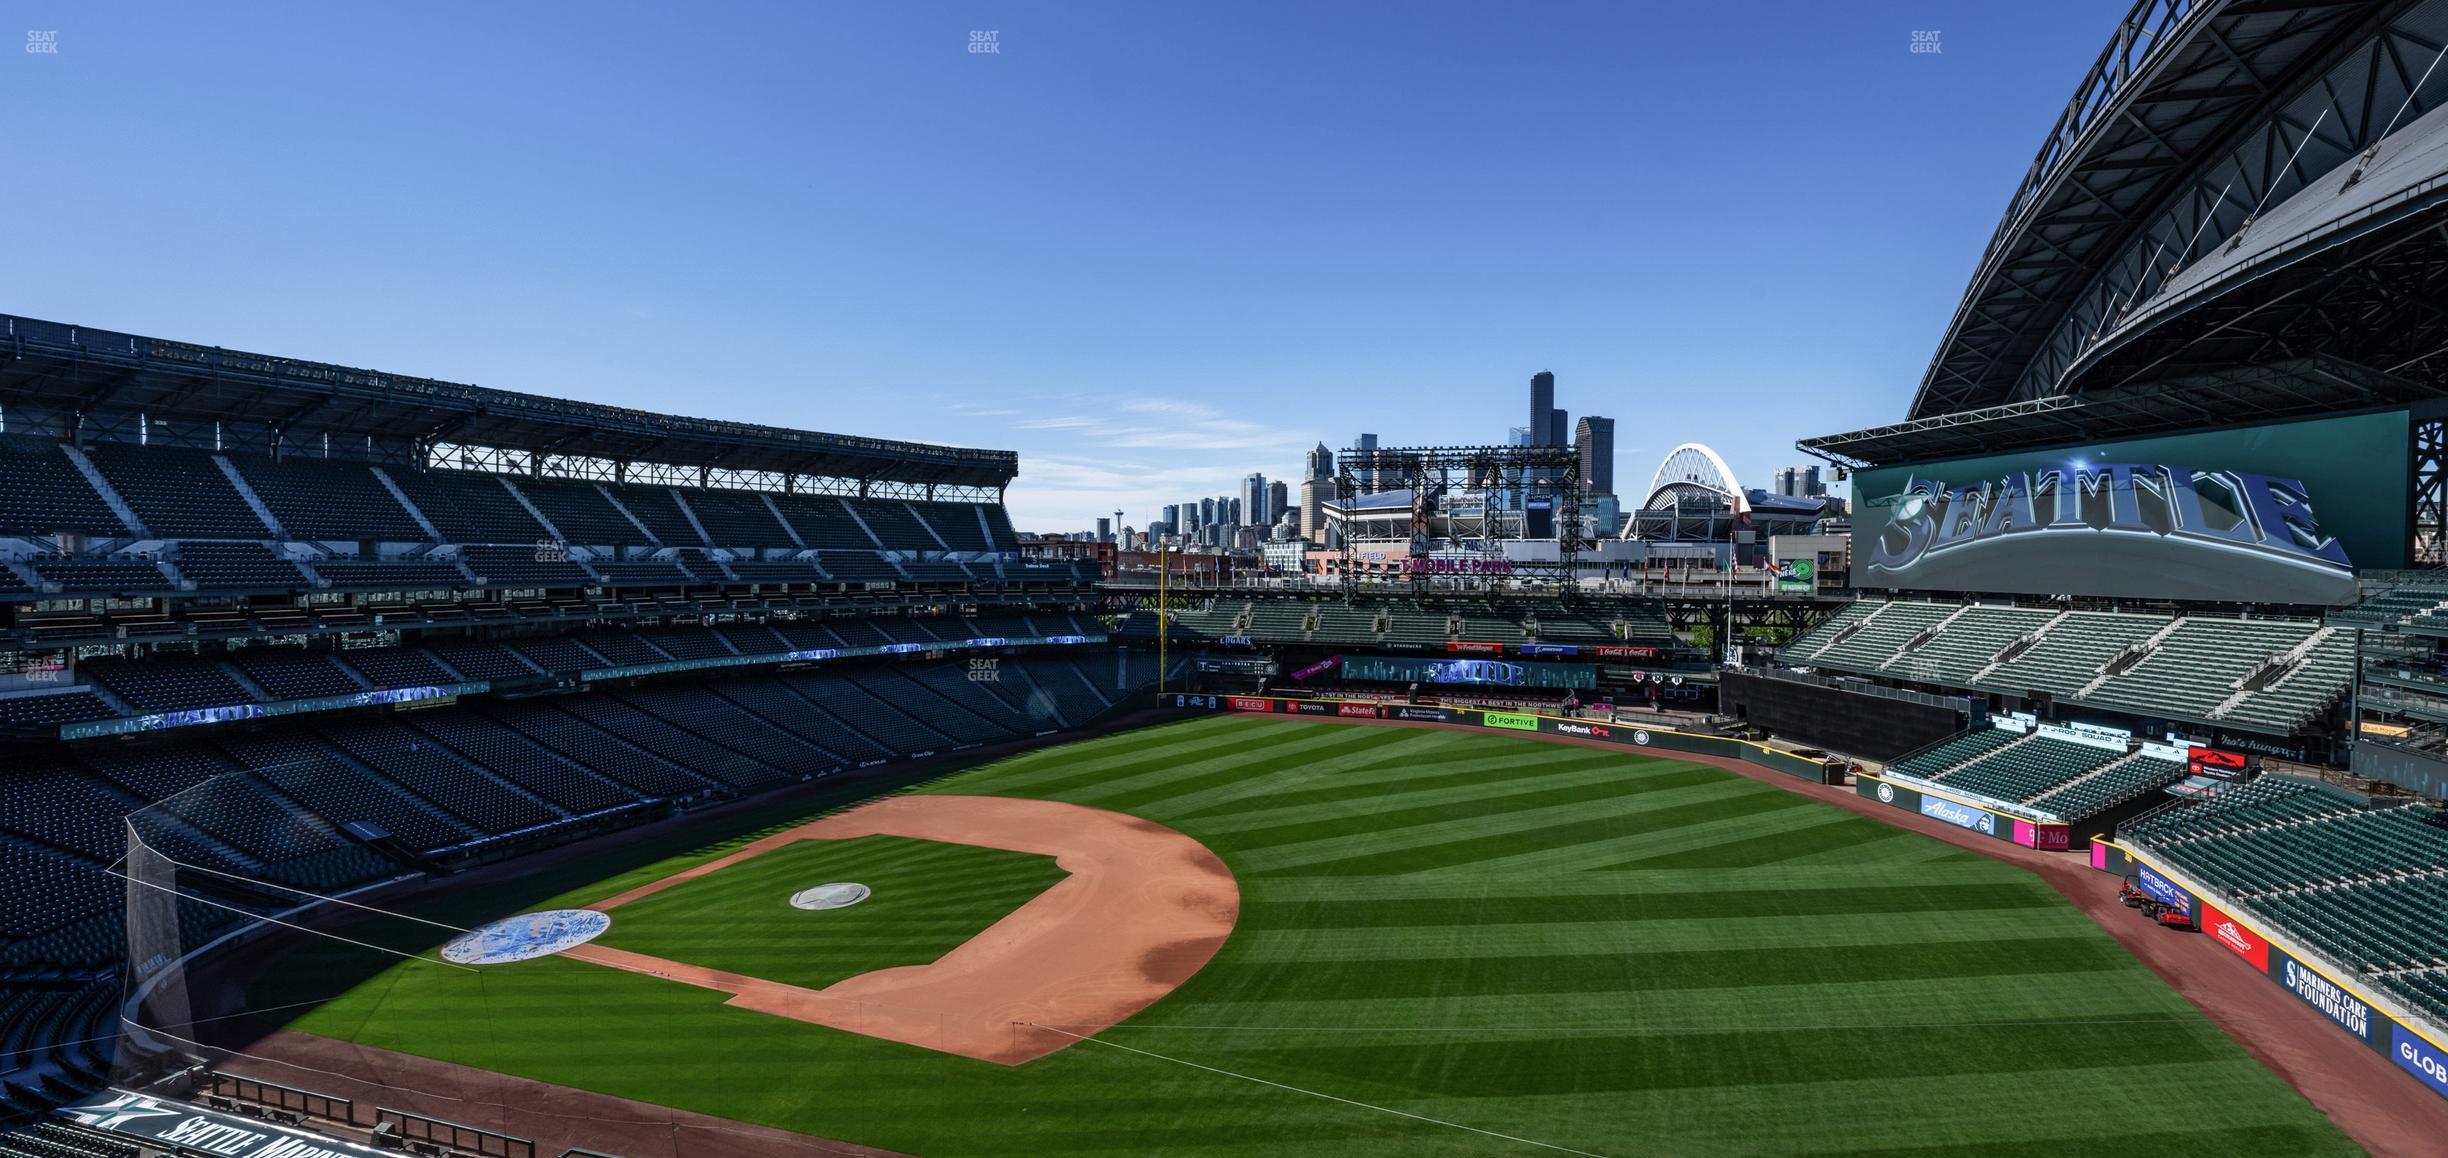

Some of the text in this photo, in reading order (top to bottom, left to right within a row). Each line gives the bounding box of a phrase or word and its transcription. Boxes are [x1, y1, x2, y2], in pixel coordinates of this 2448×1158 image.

[1868, 464, 2353, 575] SEATTLE
[1361, 552, 1386, 560] FIELD
[1472, 560, 1512, 572] PARK
[1239, 700, 1262, 708] BECU
[1300, 703, 1325, 711] TOYOTA
[1498, 717, 1534, 726] FORTIVE
[1558, 722, 1591, 735] KeyBank
[2050, 727, 2077, 736] J-ROD
[2081, 732, 2112, 742] SQUAD
[1925, 801, 1969, 823] Alaska
[2299, 967, 2341, 1004] MARINERS
[2343, 994, 2367, 1021] CARE
[2299, 982, 2367, 1038] FOUNDATION
[2401, 1042, 2448, 1085] GLOB
[157, 1116, 265, 1155] SEATTLE
